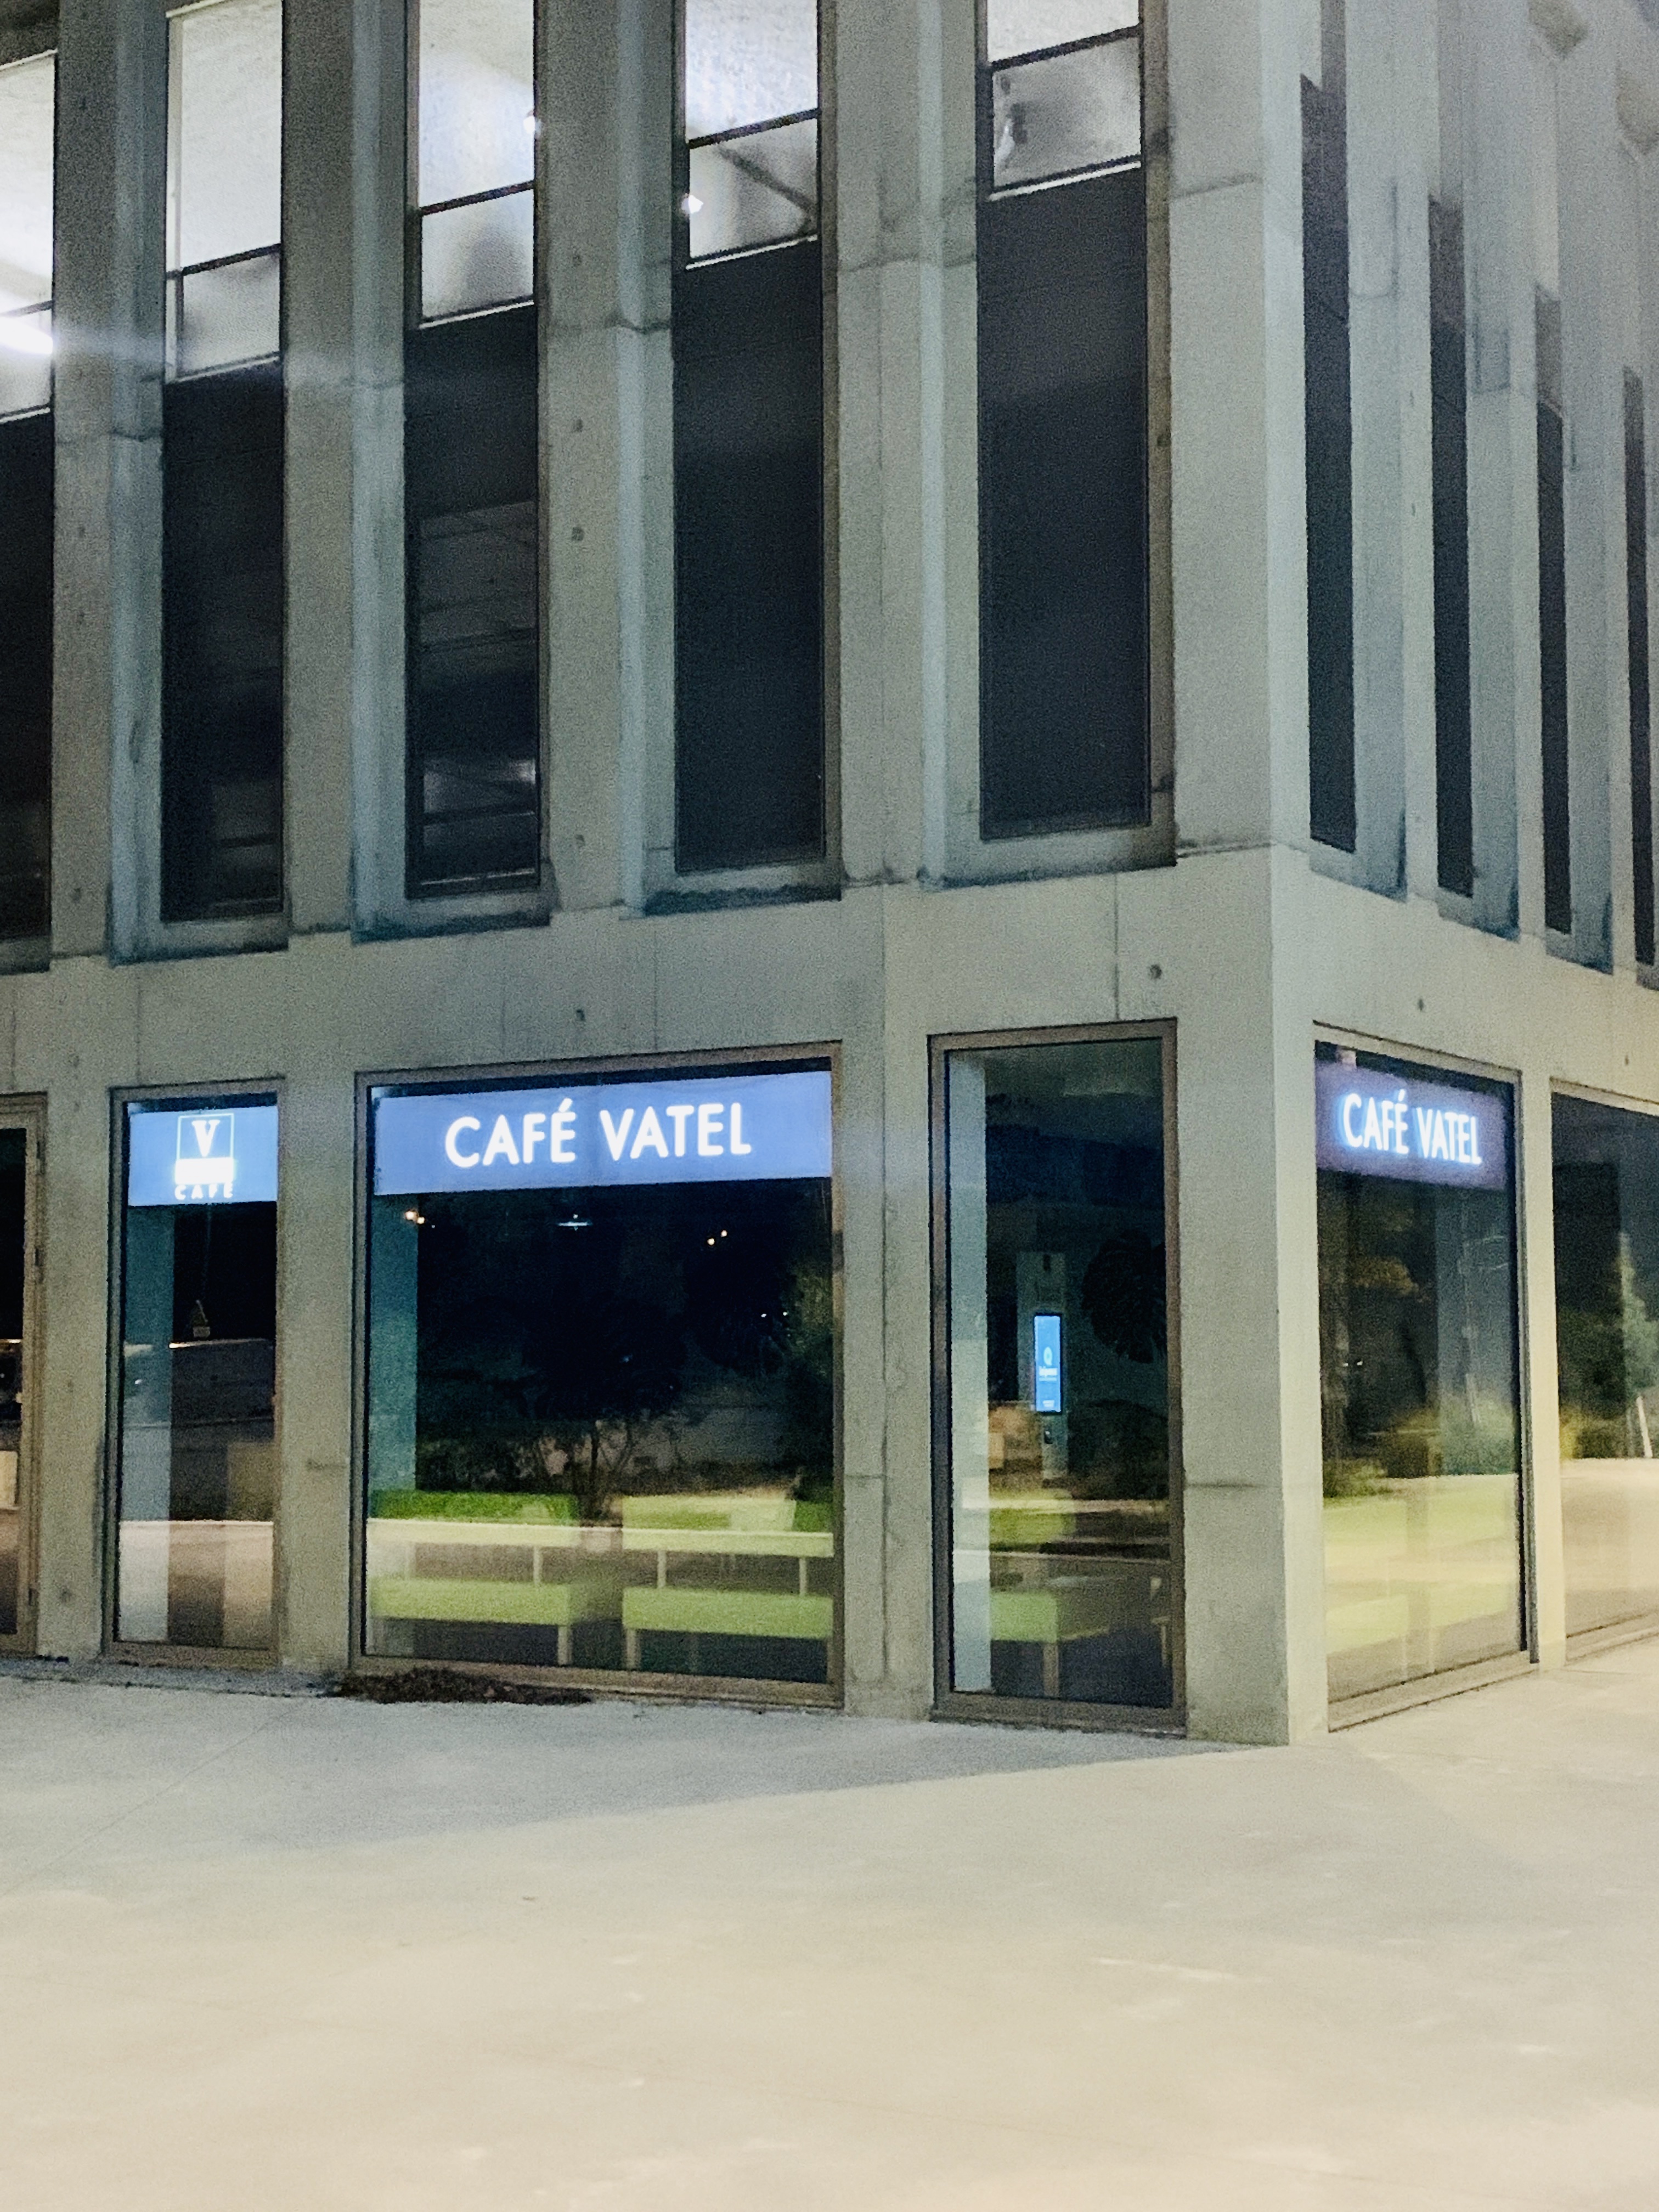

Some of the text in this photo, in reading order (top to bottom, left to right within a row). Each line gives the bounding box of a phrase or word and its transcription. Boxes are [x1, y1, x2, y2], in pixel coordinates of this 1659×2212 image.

[191, 1119, 221, 1158] V
[444, 1097, 752, 1168] CAFÉ VATEL
[1342, 1088, 1482, 1165] CAFÉ VATEL
